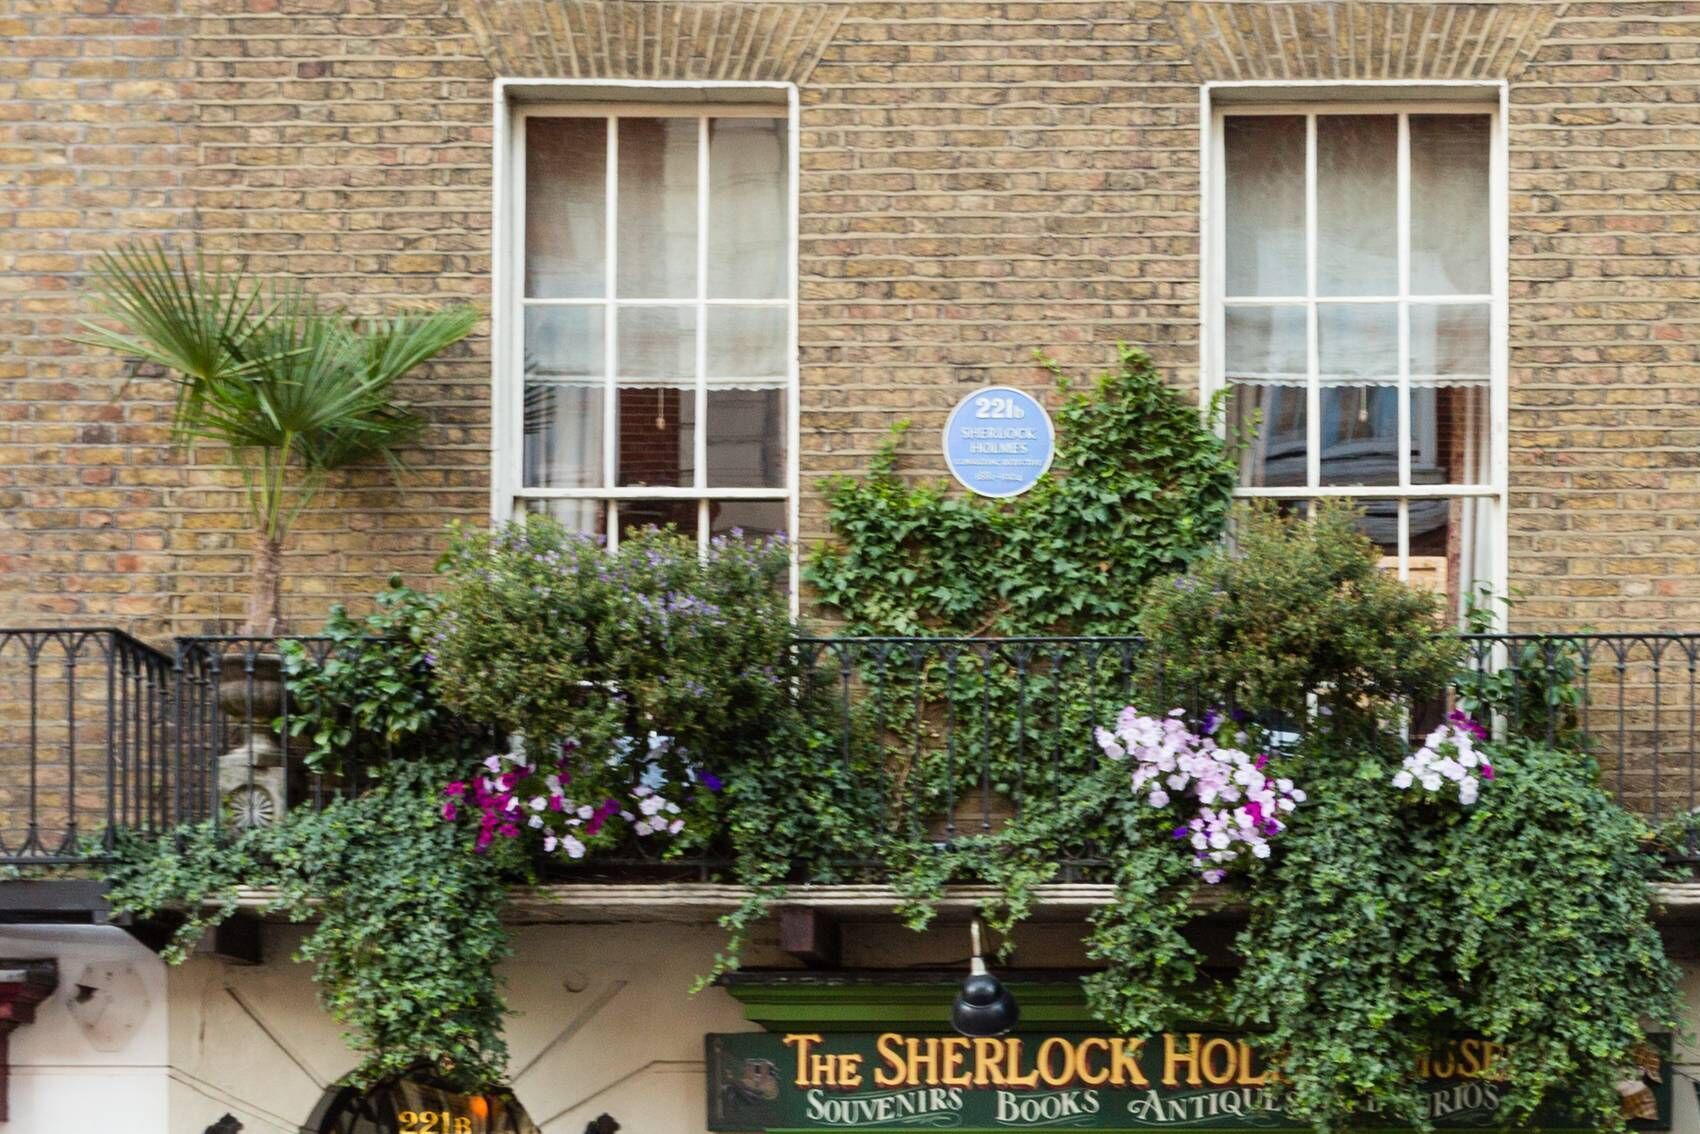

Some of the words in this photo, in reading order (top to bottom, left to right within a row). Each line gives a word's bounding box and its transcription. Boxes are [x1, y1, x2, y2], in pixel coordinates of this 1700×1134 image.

[960, 427, 1038, 439] SHERLOCK
[969, 442, 1029, 454] HOLMES
[874, 1033, 1150, 1088] SHERLOCK
[806, 1088, 964, 1124] SOUVENIRS
[995, 1089, 1100, 1122] BOOKS
